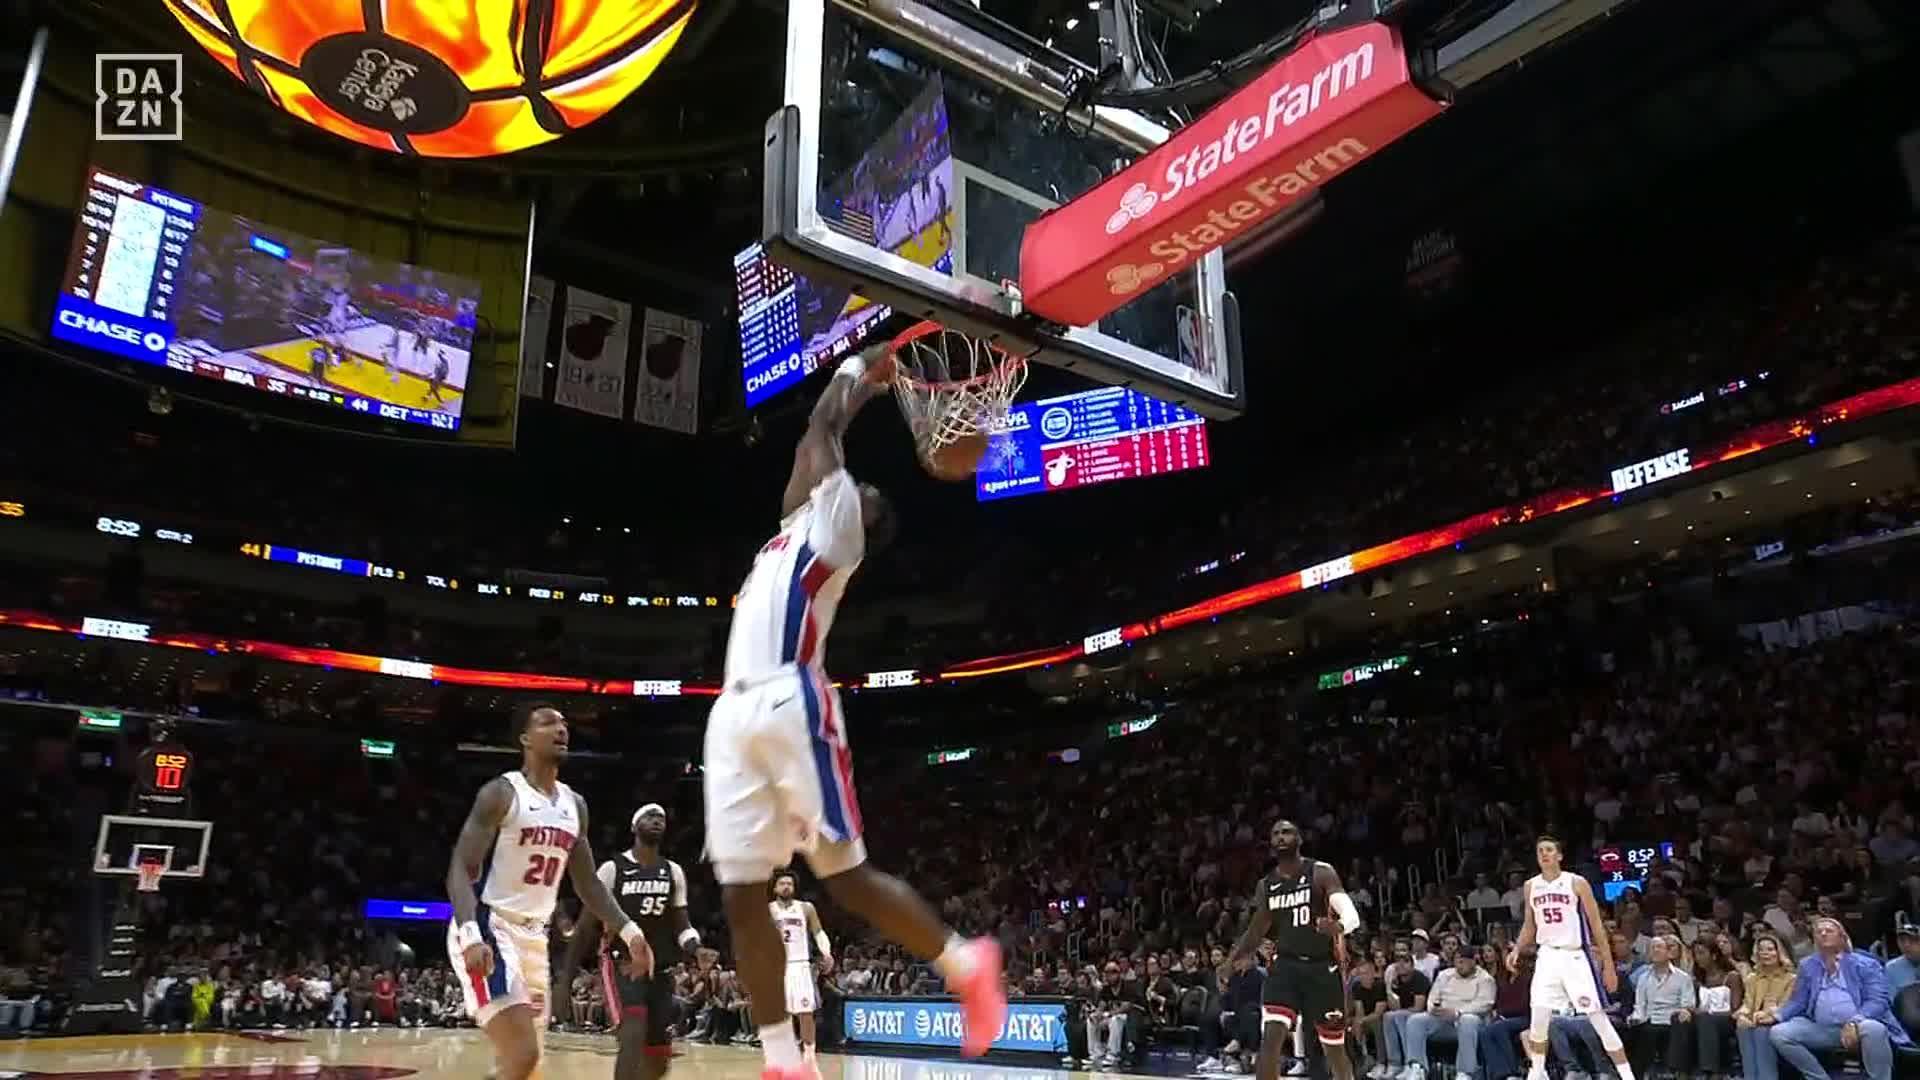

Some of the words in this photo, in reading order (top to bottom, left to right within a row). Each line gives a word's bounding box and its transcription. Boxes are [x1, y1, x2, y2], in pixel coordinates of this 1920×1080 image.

[339, 48, 390, 102] Center
[364, 59, 419, 112] Kaseya
[59, 309, 142, 345] CHASE
[746, 360, 788, 393] CHASE
[267, 378, 286, 394] 35
[352, 398, 369, 412] 44
[380, 404, 409, 421] DET
[1611, 448, 1692, 494] DEFENSE
[97, 516, 140, 537] 8:52
[477, 583, 499, 594] BLK
[579, 592, 600, 603] AST
[523, 855, 560, 888] 20
[621, 881, 671, 896] MIAMI
[1269, 889, 1311, 911] MIAMI
[639, 896, 666, 917] 95
[1292, 905, 1311, 928] 10
[1543, 907, 1562, 925] 55
[867, 1010, 905, 1036] AT&T
[1007, 1014, 1056, 1042] AT&T
